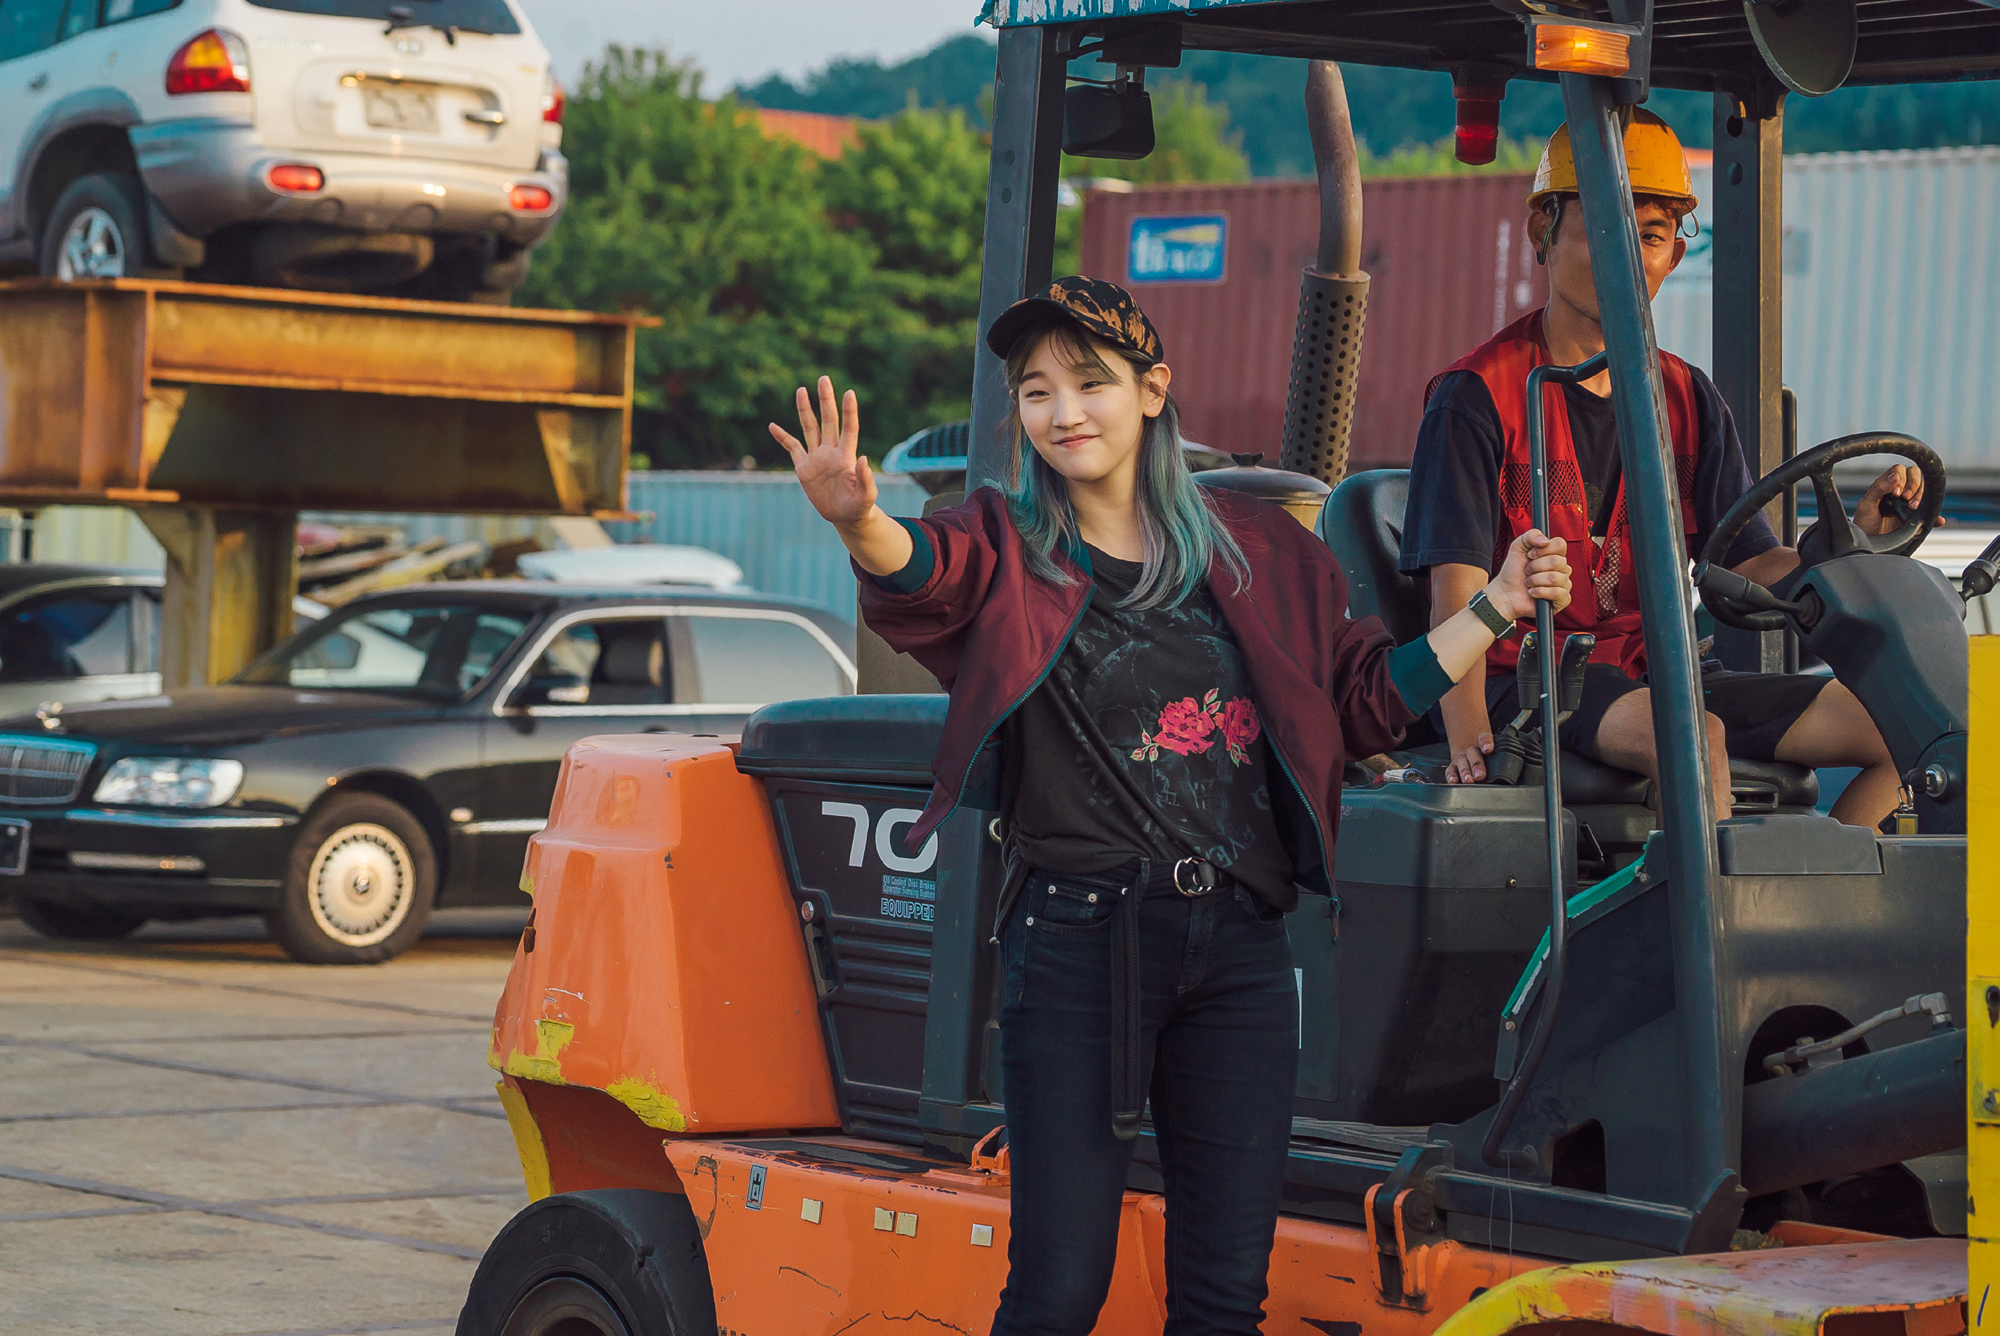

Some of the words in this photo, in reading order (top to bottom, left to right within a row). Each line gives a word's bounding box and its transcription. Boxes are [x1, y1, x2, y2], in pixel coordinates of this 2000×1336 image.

[822, 801, 938, 873] 70
[883, 884, 902, 894] Operator
[902, 887, 919, 898] Sensing
[920, 889, 935, 899] System
[891, 877, 906, 886] Cooled
[908, 879, 919, 888] Disc
[920, 880, 935, 890] Brakes
[881, 898, 935, 921] EQUIPPED
